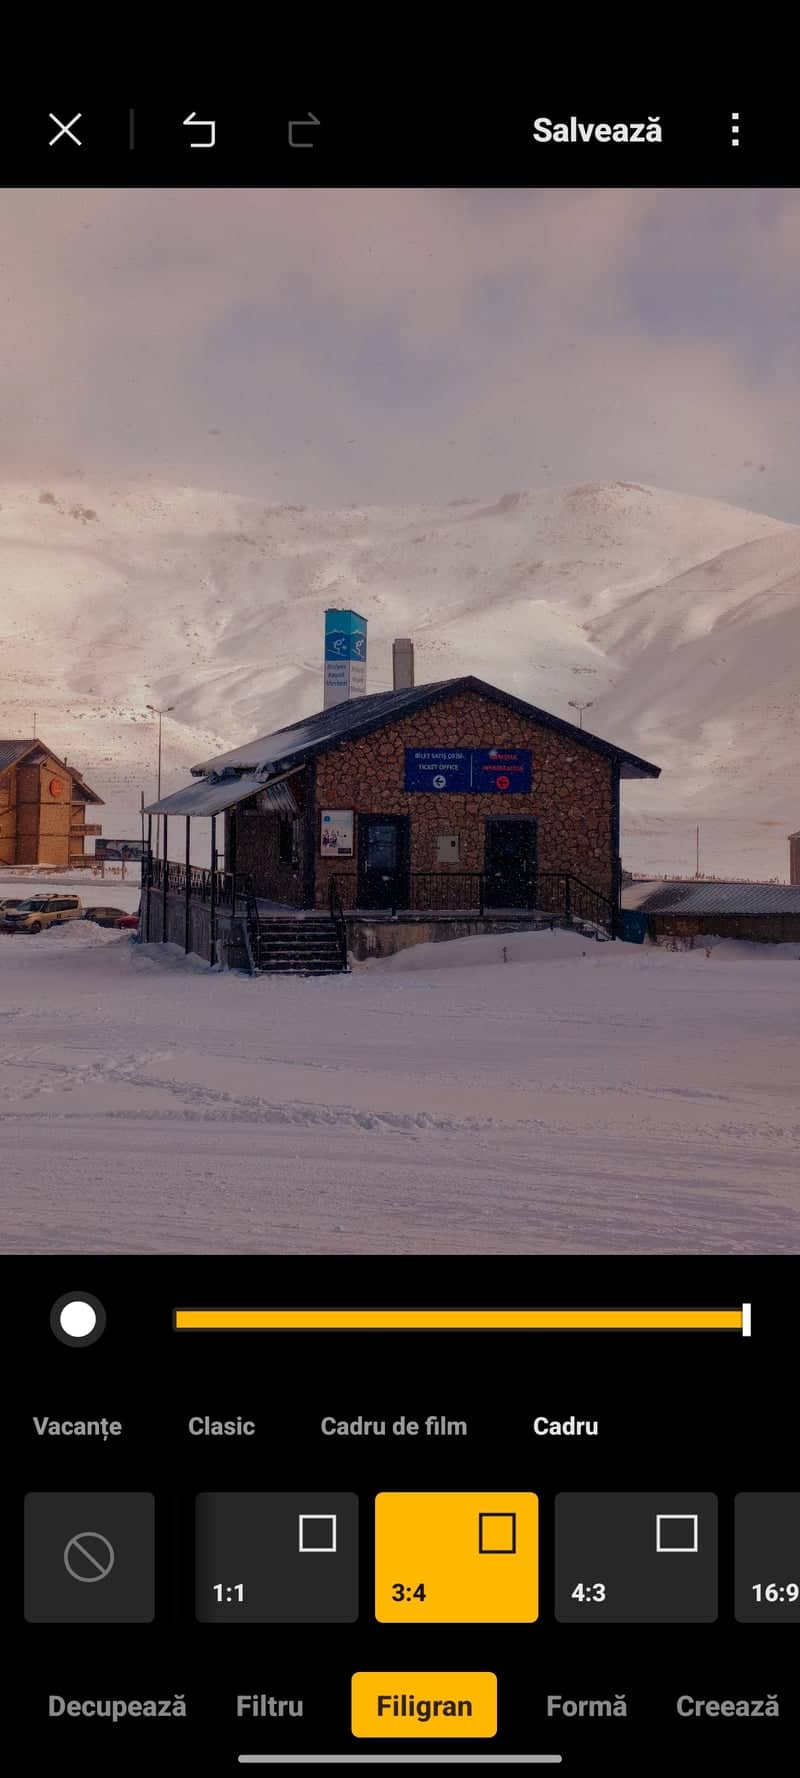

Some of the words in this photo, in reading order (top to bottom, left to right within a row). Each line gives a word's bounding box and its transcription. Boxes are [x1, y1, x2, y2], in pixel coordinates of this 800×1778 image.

[532, 116, 663, 143] Salvează
[32, 1416, 122, 1442] Vacanțe
[188, 1415, 256, 1436] Clasic
[321, 1415, 386, 1436] Cadru
[392, 1415, 420, 1436] de
[424, 1415, 467, 1436] film
[533, 1415, 599, 1436] Cadru
[212, 1583, 245, 1603] 1:1
[391, 1583, 427, 1603] 3:4
[570, 1583, 606, 1603] 4:3
[751, 1583, 800, 1603] 16:9
[48, 1694, 187, 1723] Decupează
[236, 1694, 303, 1717] Filtru
[376, 1694, 473, 1723] Filigran
[547, 1694, 627, 1718] Formă
[676, 1694, 780, 1718] Creează
